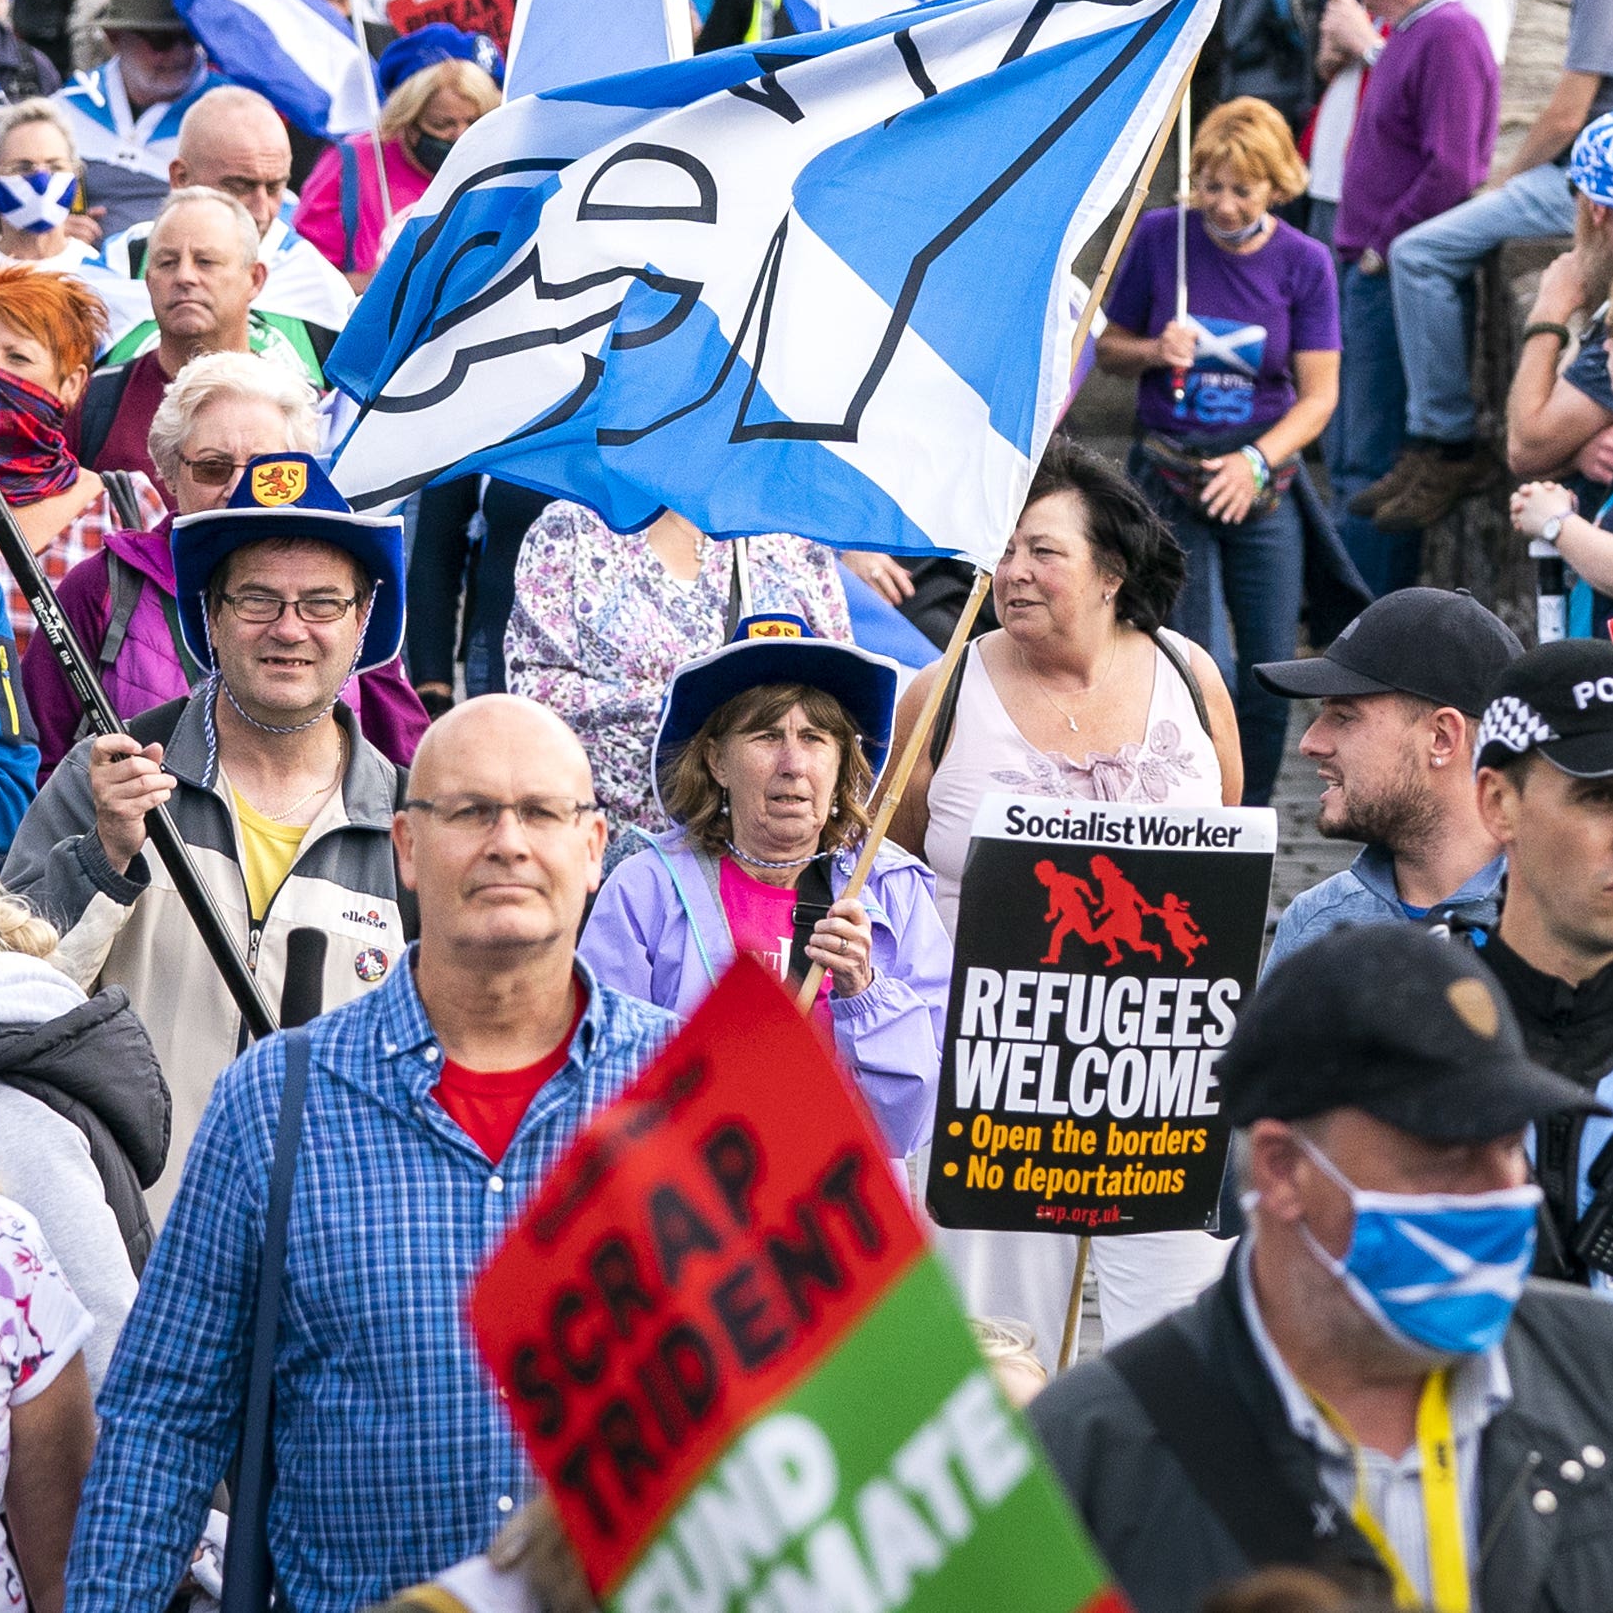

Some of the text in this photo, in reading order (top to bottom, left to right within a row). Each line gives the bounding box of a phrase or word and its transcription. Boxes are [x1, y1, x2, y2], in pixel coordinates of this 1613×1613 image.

[1004, 804, 1243, 849] Socialist Worker
[342, 910, 388, 930] ellesse
[959, 966, 1242, 1048] REFUGEES
[954, 1038, 1228, 1120] WELCOME
[971, 1114, 1208, 1158] Open the borders
[965, 1154, 1187, 1200] No deportations
[1036, 1204, 1121, 1227] swp.org.uk
[510, 1123, 761, 1438] SCRAP
[555, 1139, 885, 1540] TRIDENT
